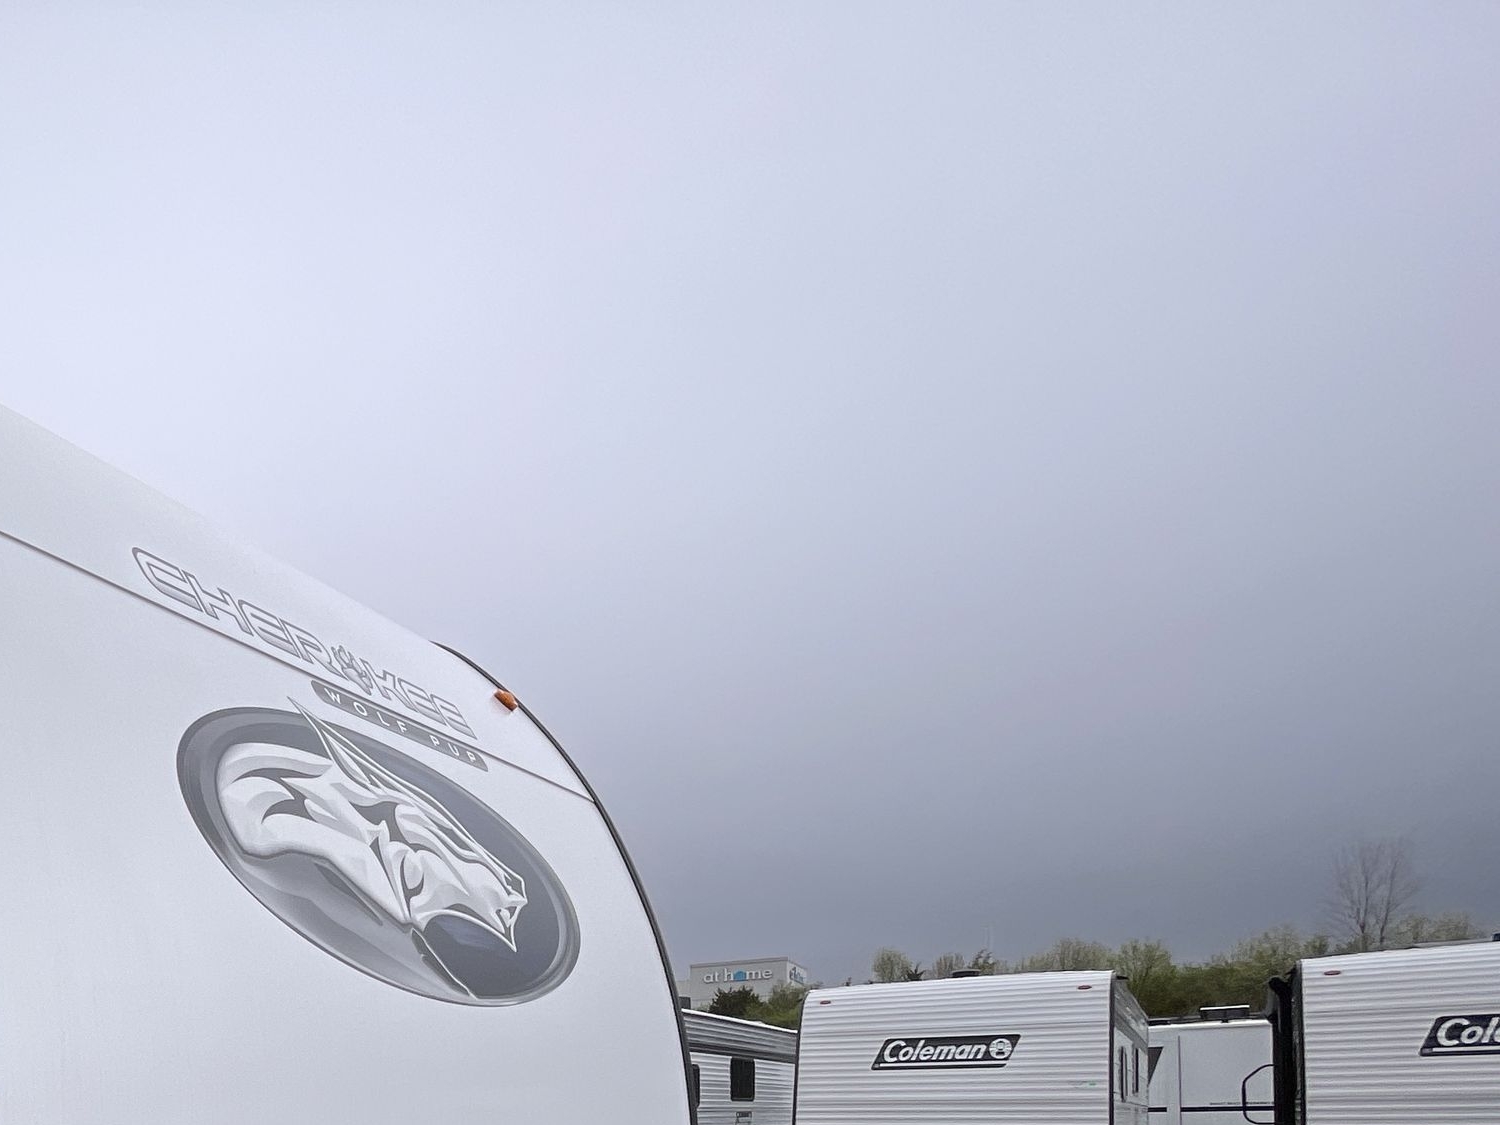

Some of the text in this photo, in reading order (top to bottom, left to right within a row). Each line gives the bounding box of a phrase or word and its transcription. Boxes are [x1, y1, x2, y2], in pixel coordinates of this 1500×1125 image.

[324, 687, 477, 764] WOLF PUP
[703, 971, 719, 983] at
[883, 1039, 987, 1063] Coleman
